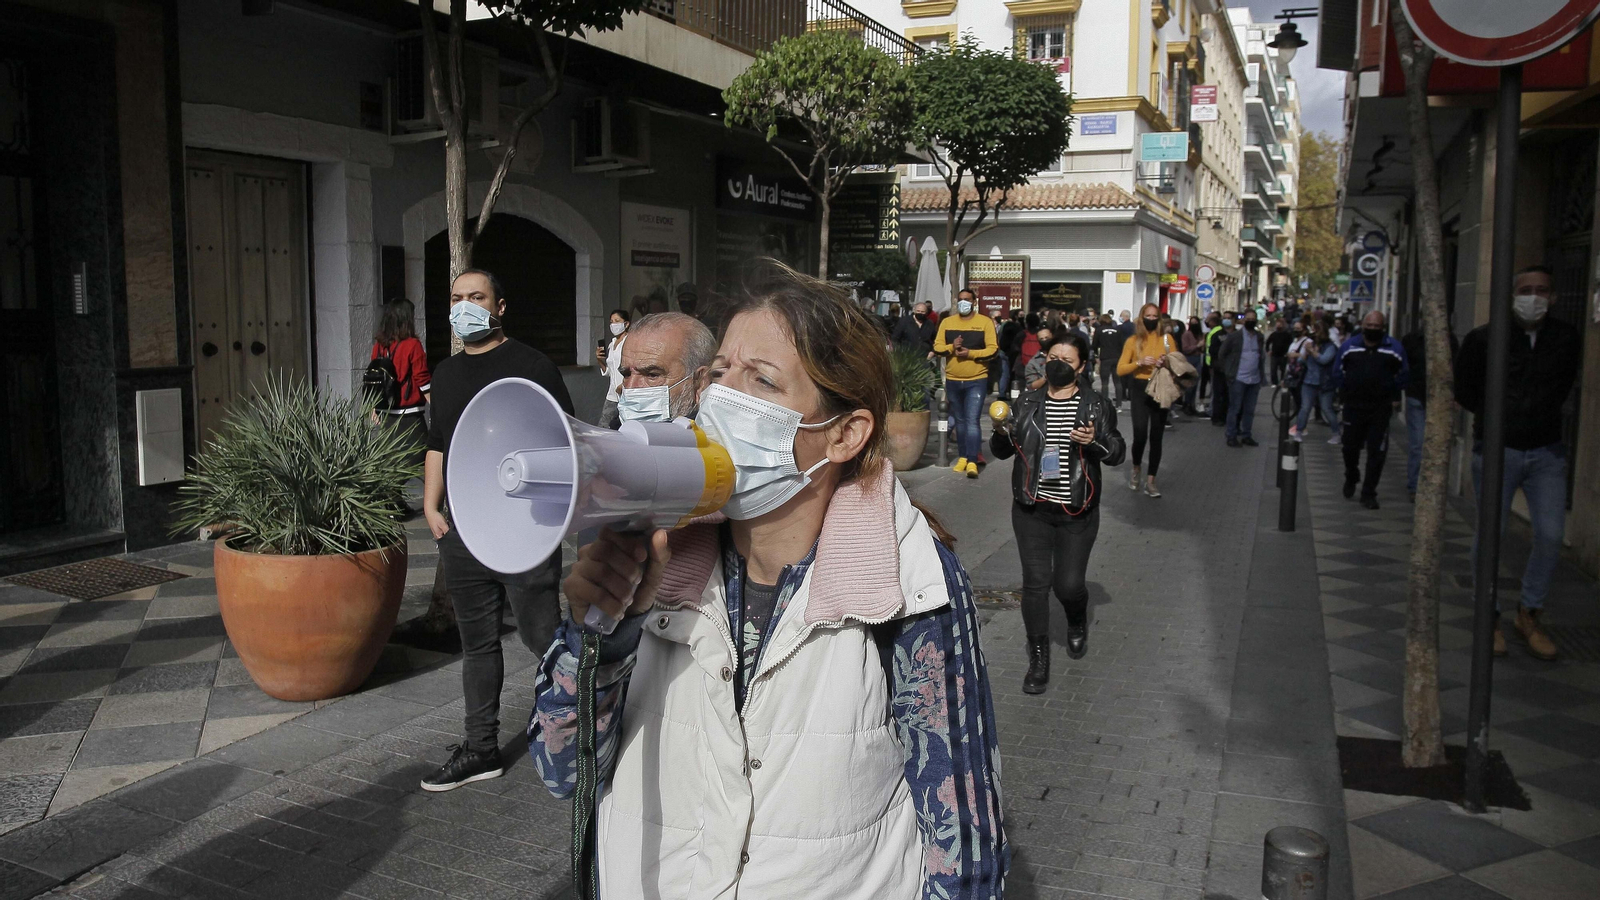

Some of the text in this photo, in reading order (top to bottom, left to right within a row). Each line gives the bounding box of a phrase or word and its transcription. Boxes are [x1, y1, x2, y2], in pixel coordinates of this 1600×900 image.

[744, 174, 779, 205] Aural
[637, 213, 675, 226] WIDEX EVOKE
